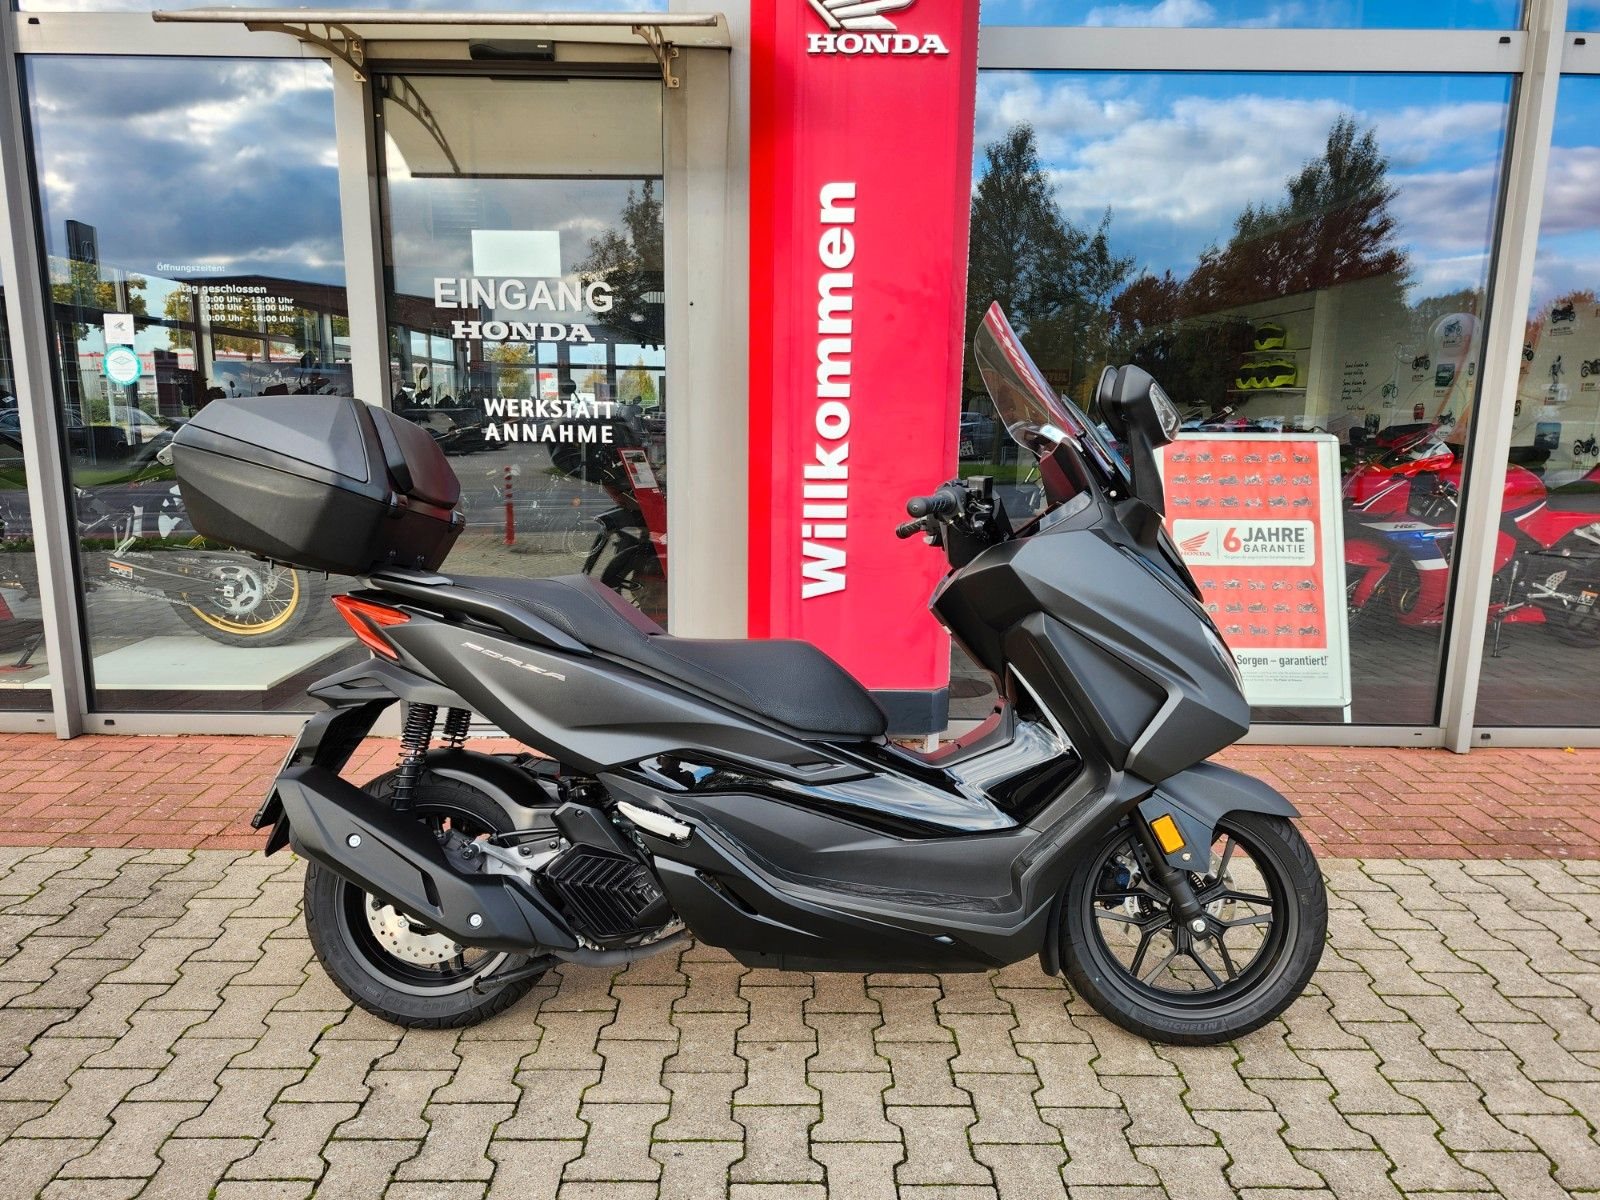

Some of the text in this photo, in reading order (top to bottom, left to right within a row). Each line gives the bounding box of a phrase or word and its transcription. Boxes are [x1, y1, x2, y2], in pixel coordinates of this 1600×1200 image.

[807, 33, 949, 55] HONDA
[156, 262, 225, 273] Öffnungszeiten:
[202, 284, 267, 294] geschlossen
[433, 277, 613, 313] EINGANG
[200, 295, 224, 303] 10:00
[251, 296, 276, 304] 13:00
[201, 303, 225, 311] 14:00
[252, 304, 276, 312] 18:00
[279, 304, 295, 312] Uhr
[202, 314, 225, 322] 10:00
[228, 314, 243, 322] Uhr
[279, 315, 295, 323] Uhr
[451, 320, 595, 342] HONDA
[801, 182, 858, 599] Willkommen
[484, 398, 614, 419] WERKSTATT
[484, 422, 614, 443] ANNAHME
[1223, 527, 1305, 552] 6 JAHRE
[1243, 544, 1305, 553] GARANTIE
[1237, 655, 1268, 667] Sorgen
[1279, 655, 1327, 667] garantiert!
[1157, 1018, 1218, 1031] MICHELIN
